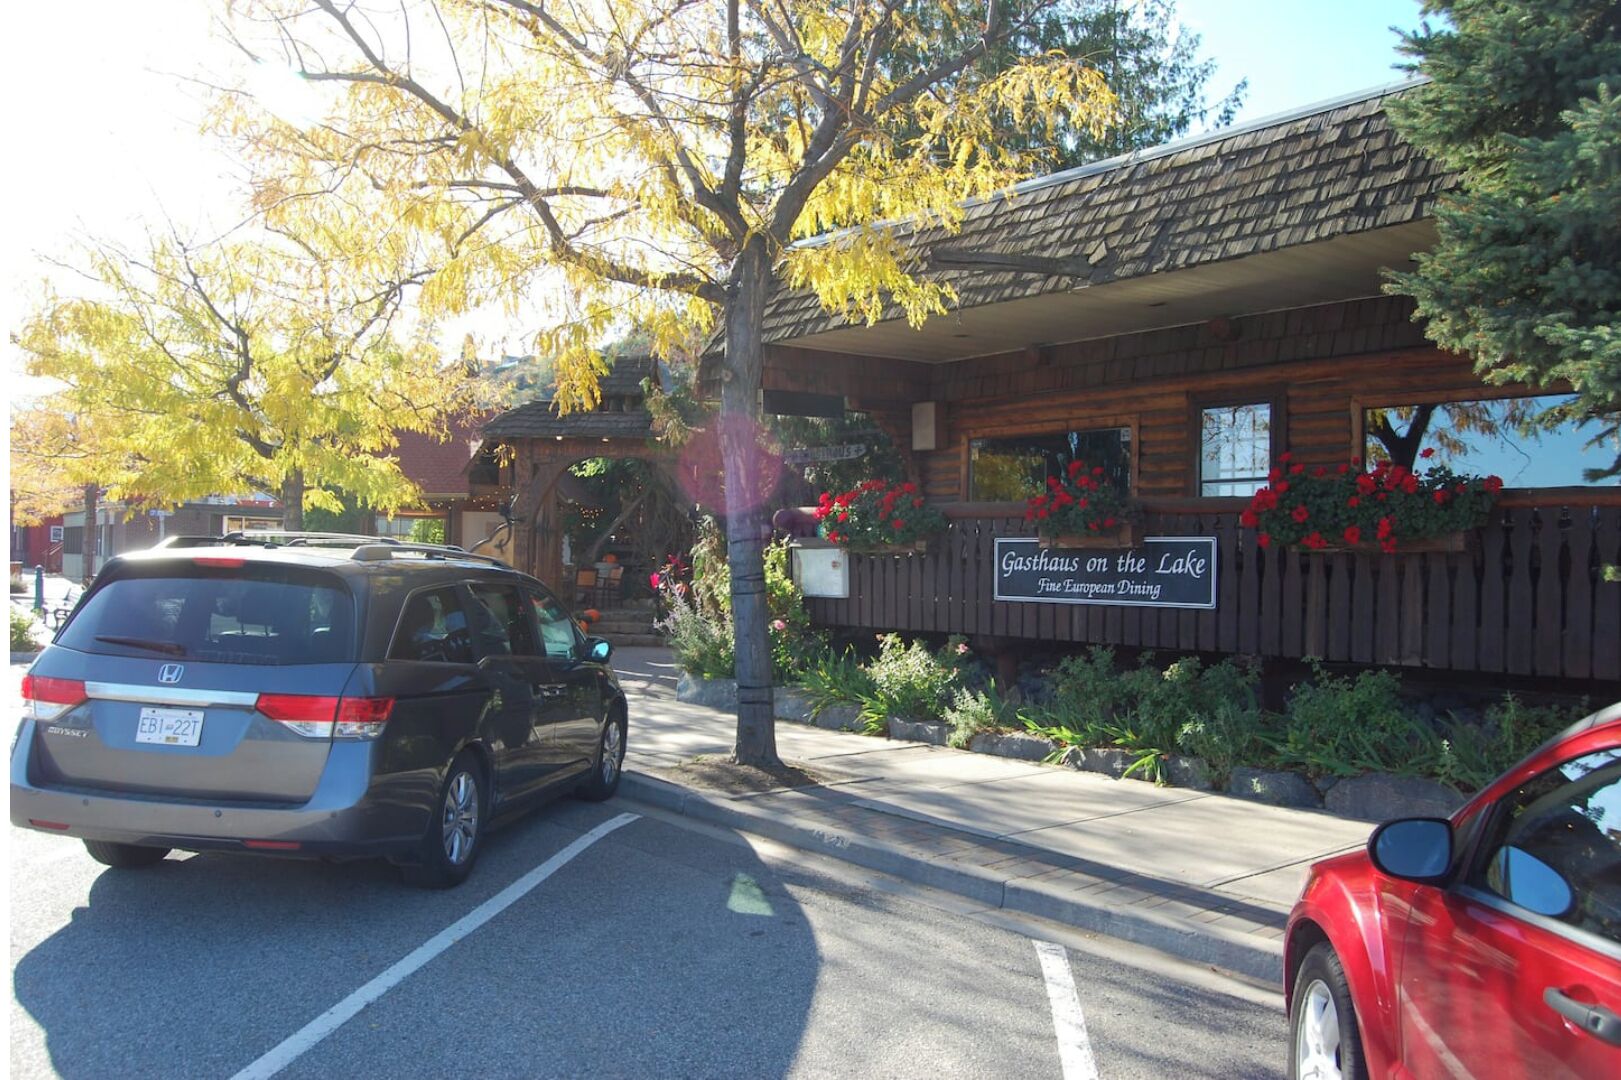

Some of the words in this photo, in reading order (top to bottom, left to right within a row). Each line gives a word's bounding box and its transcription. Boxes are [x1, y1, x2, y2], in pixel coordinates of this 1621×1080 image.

[1002, 549, 1079, 577] Gasthaus
[1086, 557, 1108, 572] on
[1117, 550, 1146, 573] the
[1155, 549, 1206, 578] Lake
[1037, 577, 1061, 594] Fine
[1063, 579, 1115, 597] European
[1117, 581, 1161, 599] Dining
